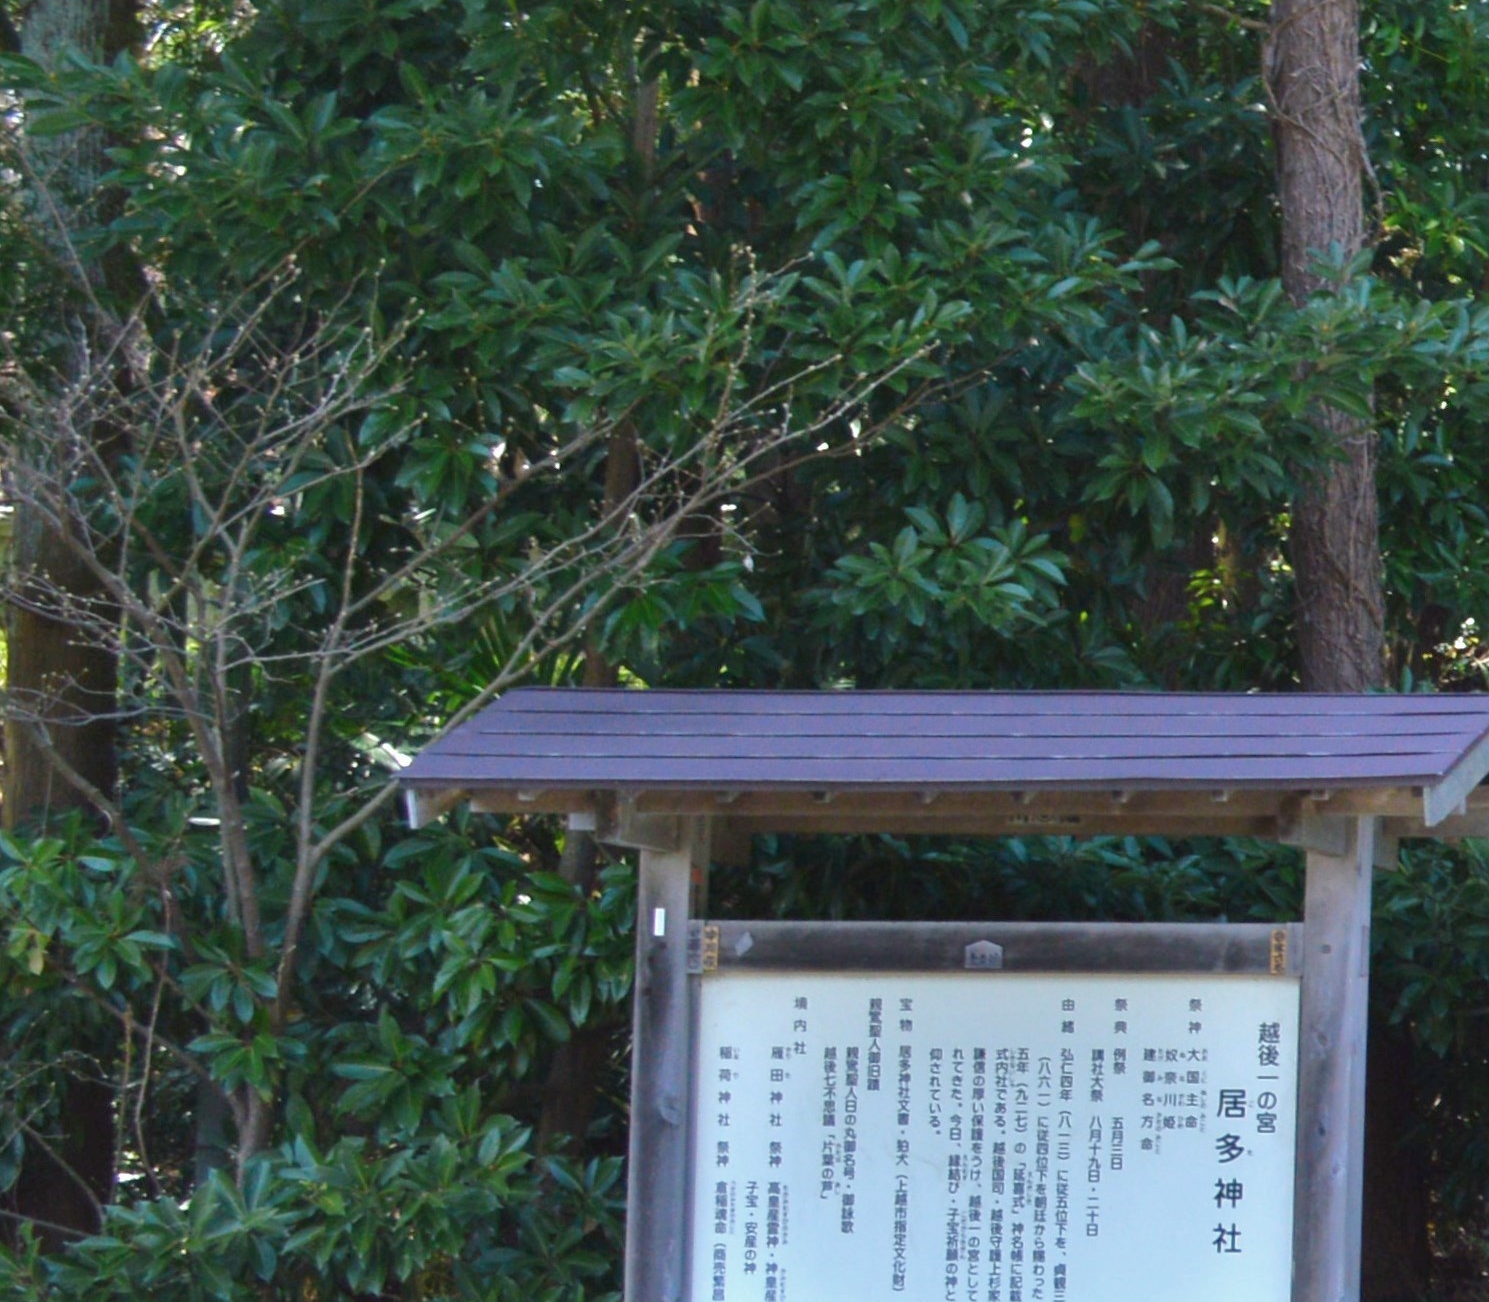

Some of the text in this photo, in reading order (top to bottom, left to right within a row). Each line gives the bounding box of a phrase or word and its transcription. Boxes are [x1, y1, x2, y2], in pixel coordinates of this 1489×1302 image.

[793, 997, 808, 1055] 境内社
[899, 998, 913, 1032] 宝物
[1185, 998, 1203, 1129] 祭神 大国主命
[717, 1047, 733, 1127] 稲荷神社
[1111, 998, 1128, 1170] 祭典 例祭 五月三日
[1141, 1048, 1157, 1151] 建御名方命
[1163, 1049, 1178, 1130] 奴奈川姫
[1256, 1022, 1280, 1134] 越後一の宮
[1213, 1089, 1247, 1253] 居多神社
